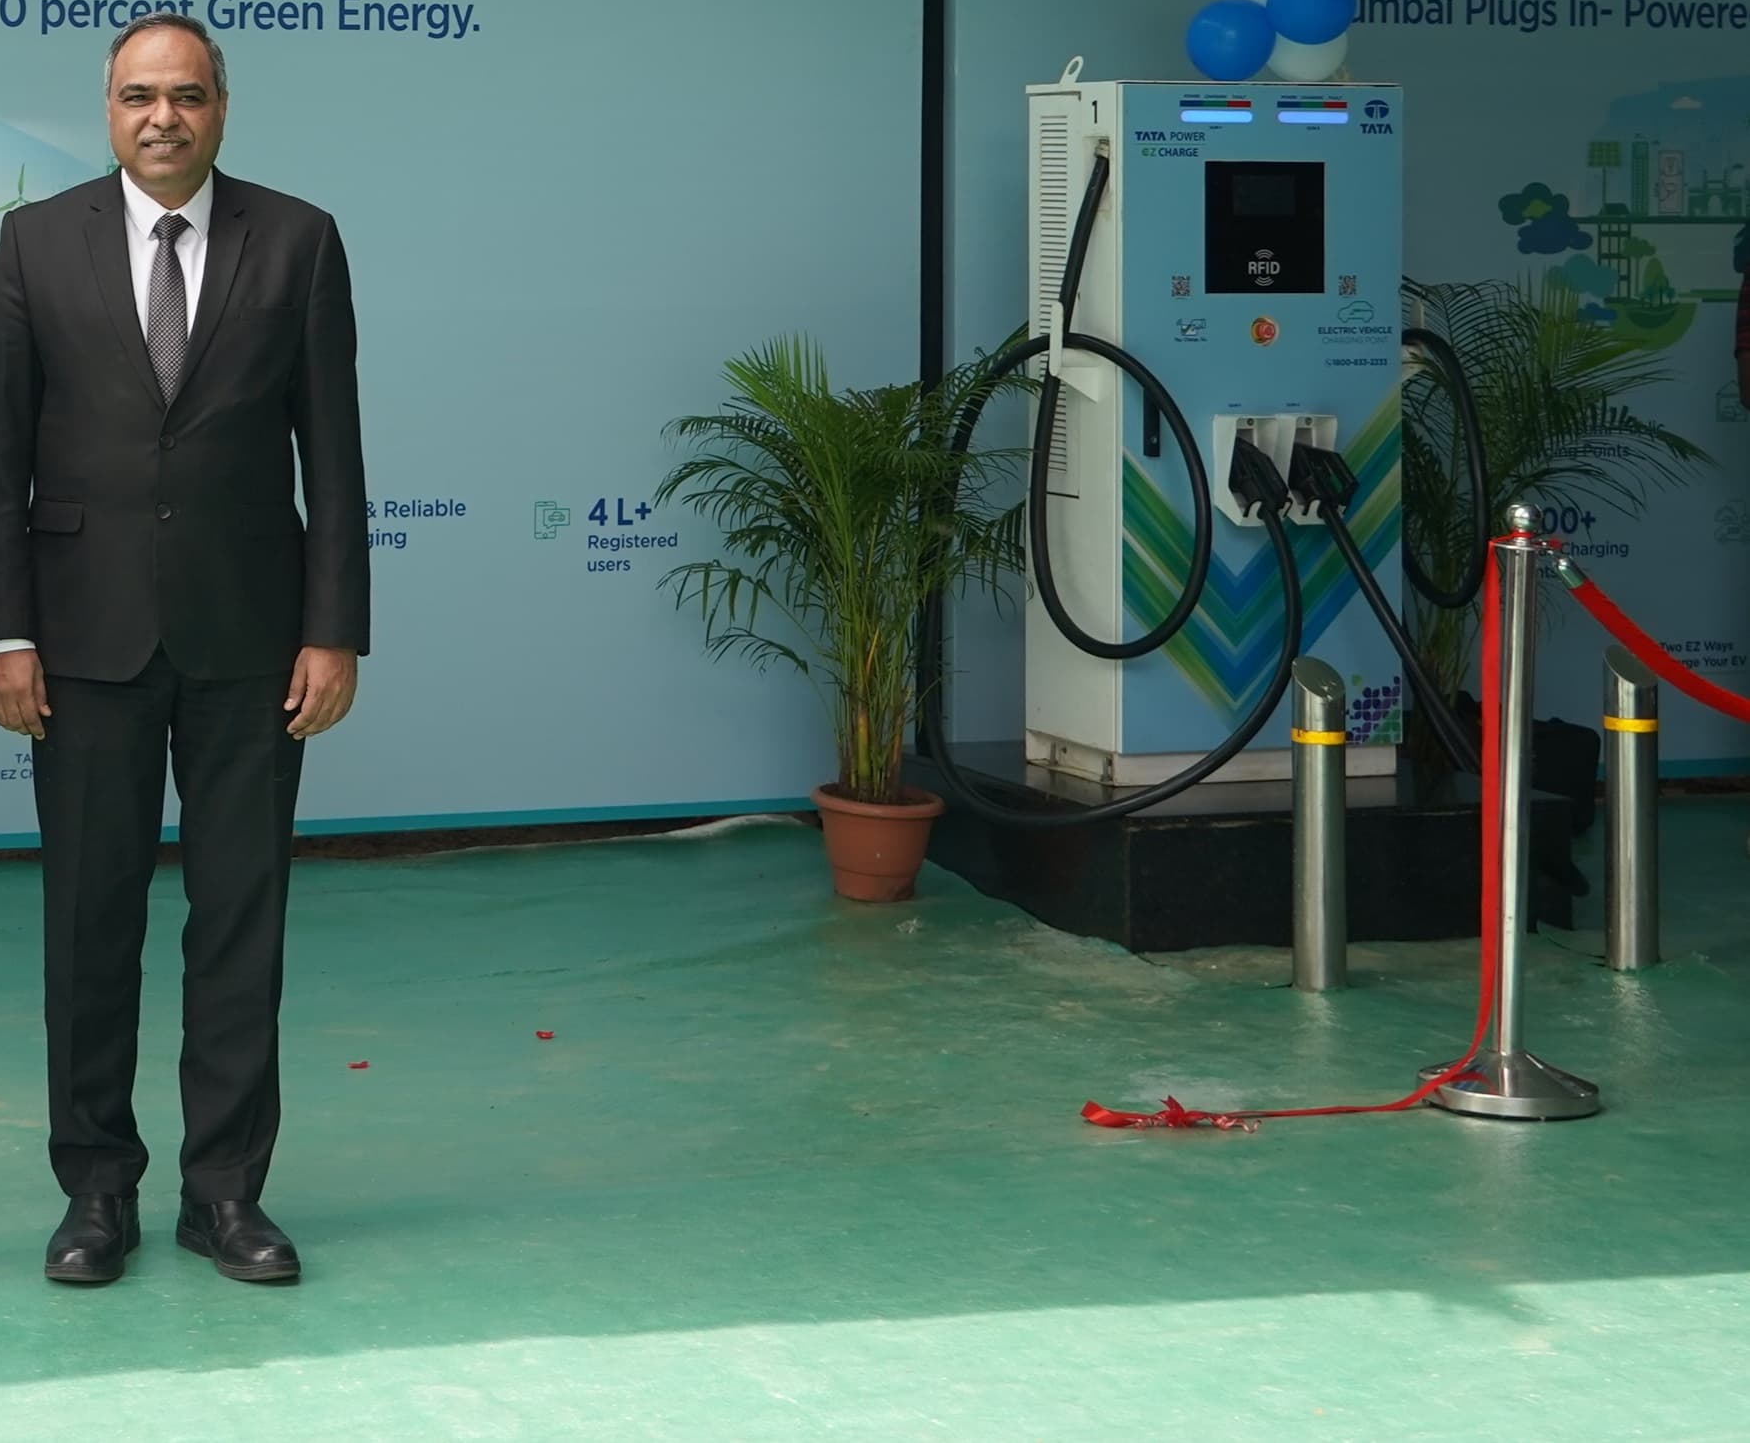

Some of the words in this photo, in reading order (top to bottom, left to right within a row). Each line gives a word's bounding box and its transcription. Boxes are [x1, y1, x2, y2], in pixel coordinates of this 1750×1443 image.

[1091, 99, 1098, 125] 1
[1360, 123, 1394, 135] TATA
[1135, 131, 1166, 142] TATA
[1170, 131, 1206, 142] POWER
[1158, 147, 1199, 158] CHARGE
[1248, 260, 1281, 276] RFID
[1318, 326, 1357, 335] ELECTRIC
[384, 498, 467, 519] Reliable
[587, 497, 608, 526] 4
[617, 497, 652, 526] L+
[587, 532, 678, 552] Registered
[587, 559, 631, 572] users
[1, 769, 17, 780] EZ
